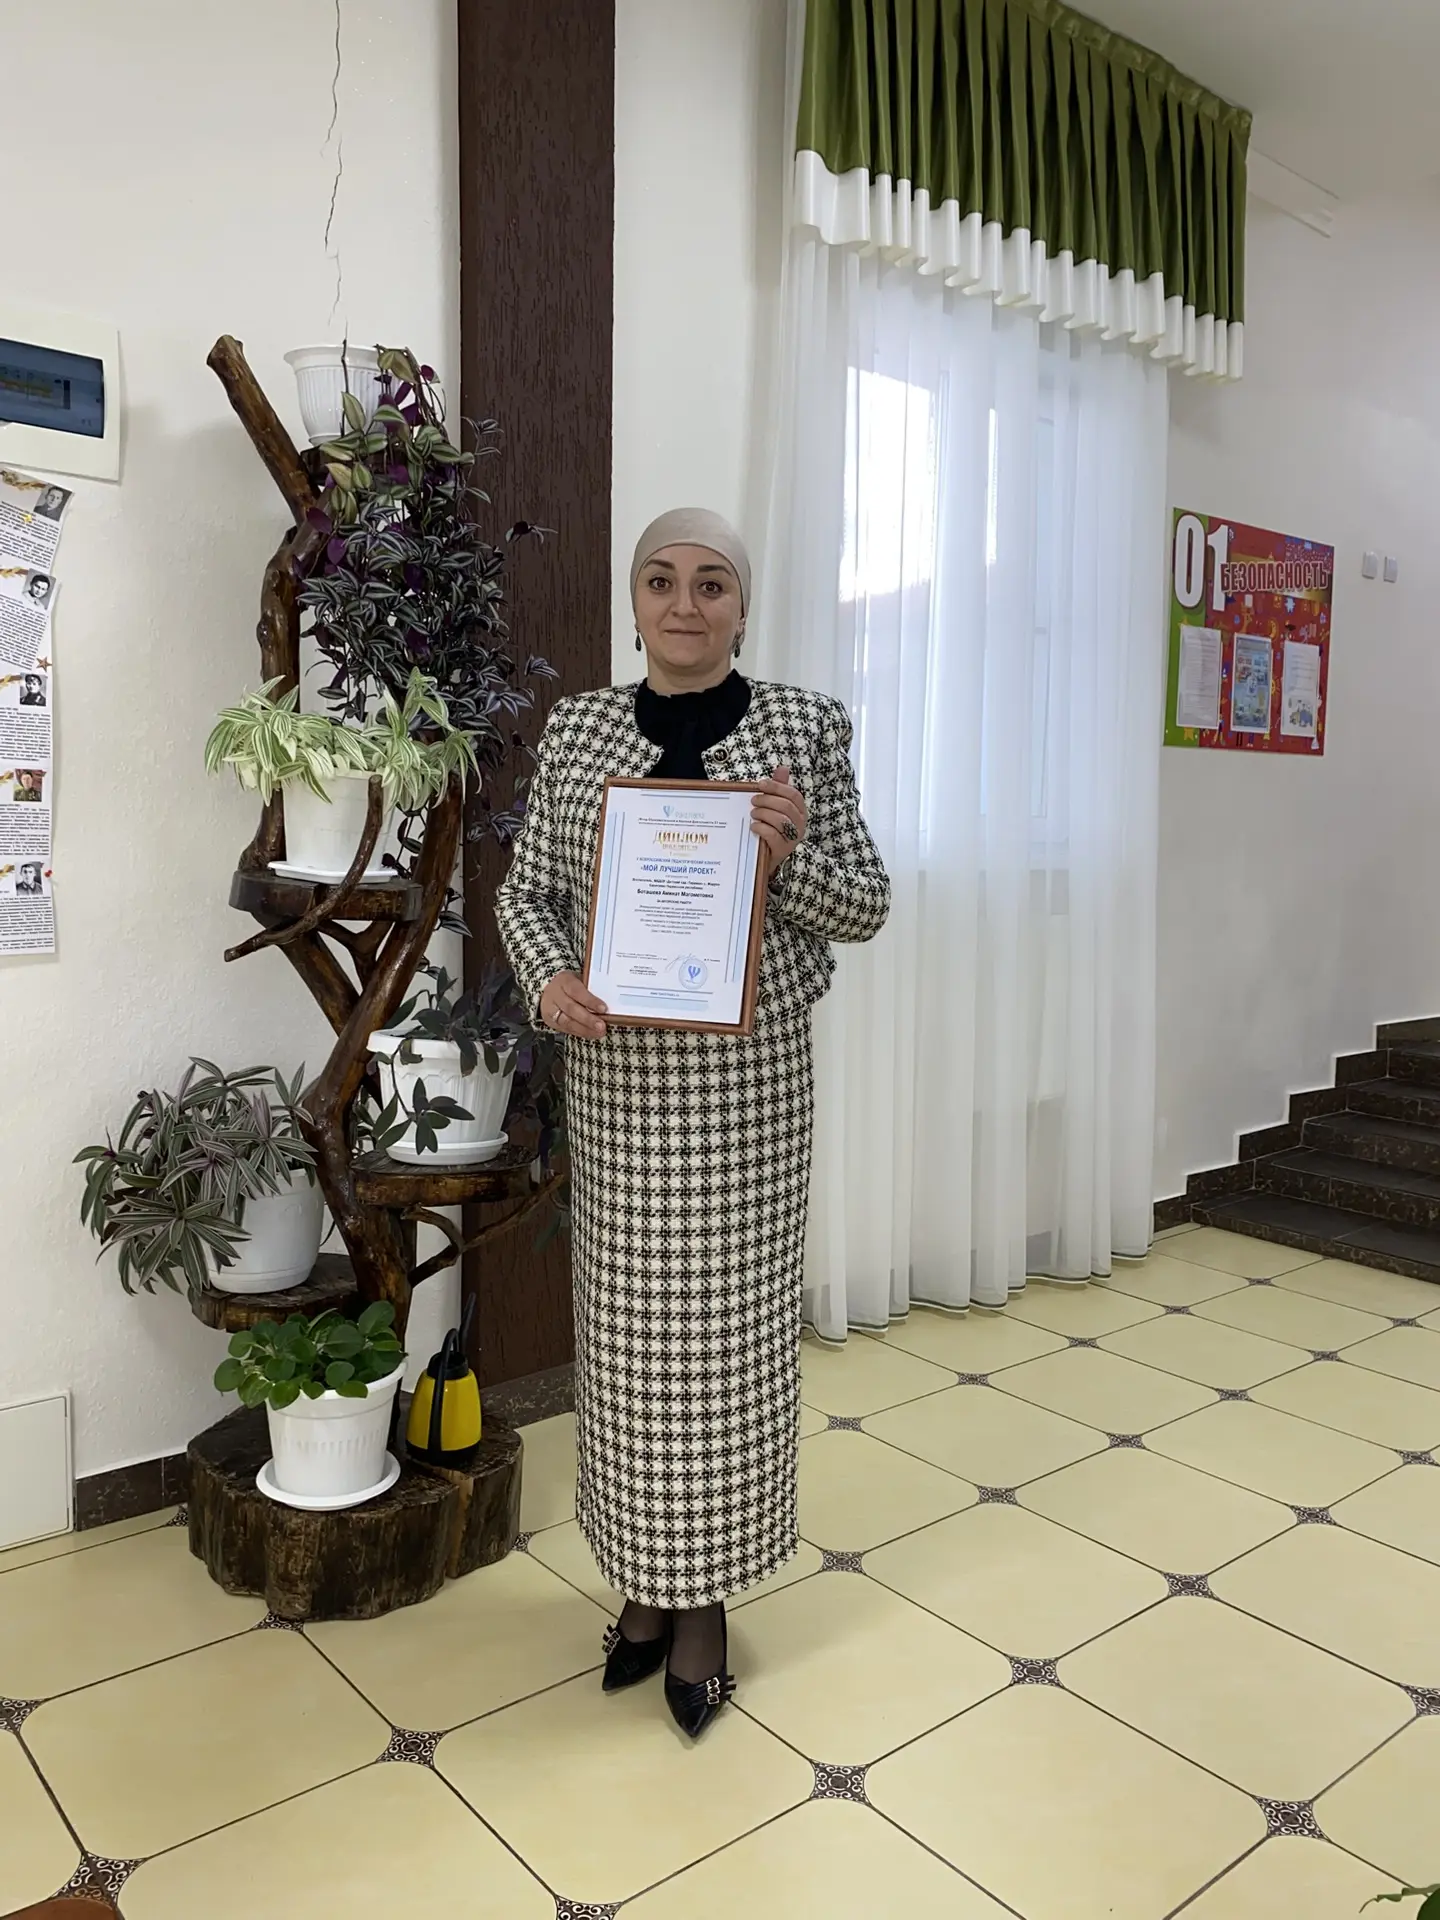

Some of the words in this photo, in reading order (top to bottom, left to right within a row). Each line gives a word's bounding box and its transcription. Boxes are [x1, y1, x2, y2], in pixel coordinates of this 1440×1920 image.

[1174, 513, 1229, 612] 01
[1220, 561, 1329, 593] БЕЗОПАСНОСТЬ
[652, 829, 709, 844] ДИПЛОМ
[659, 865, 688, 873] ЛУЧШИЙ
